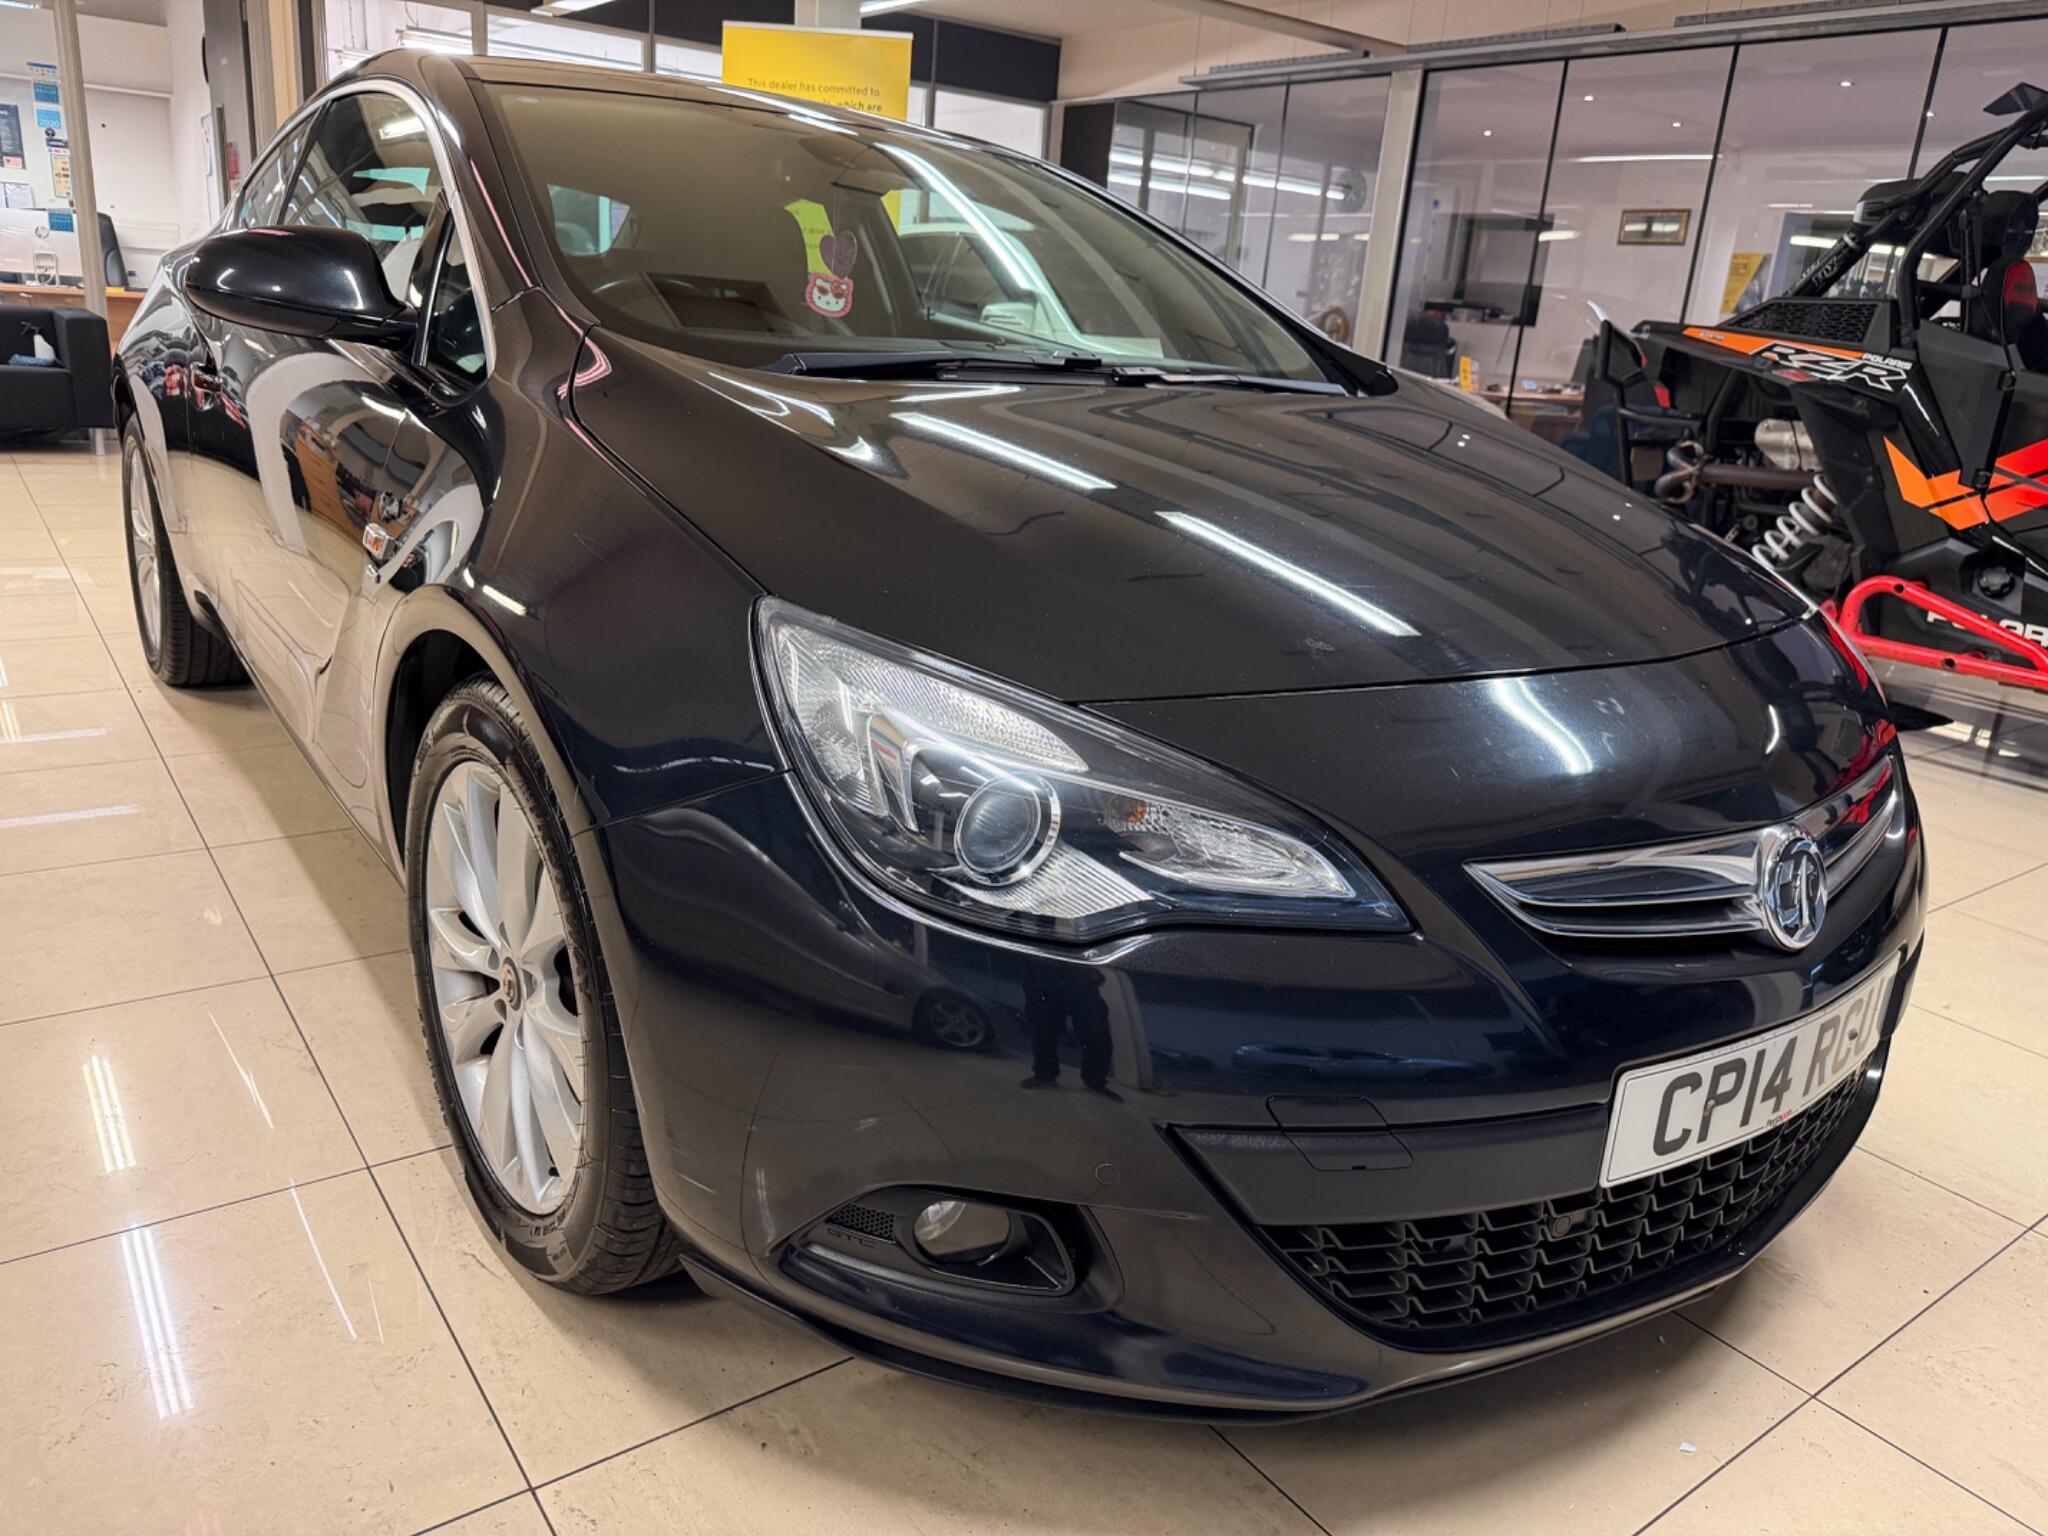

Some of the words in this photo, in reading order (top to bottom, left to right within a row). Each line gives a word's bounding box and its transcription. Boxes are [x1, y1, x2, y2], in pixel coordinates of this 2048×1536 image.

[748, 78, 767, 88] This
[768, 80, 797, 90] dealer
[800, 81, 815, 91] has
[818, 84, 868, 96] committed
[870, 86, 880, 97] to
[867, 103, 882, 112] are
[1752, 342, 1907, 391] RZR
[1862, 352, 1913, 370] POLARIS
[1653, 1036, 1798, 1156] CP14
[1802, 974, 1884, 1097] RCU
